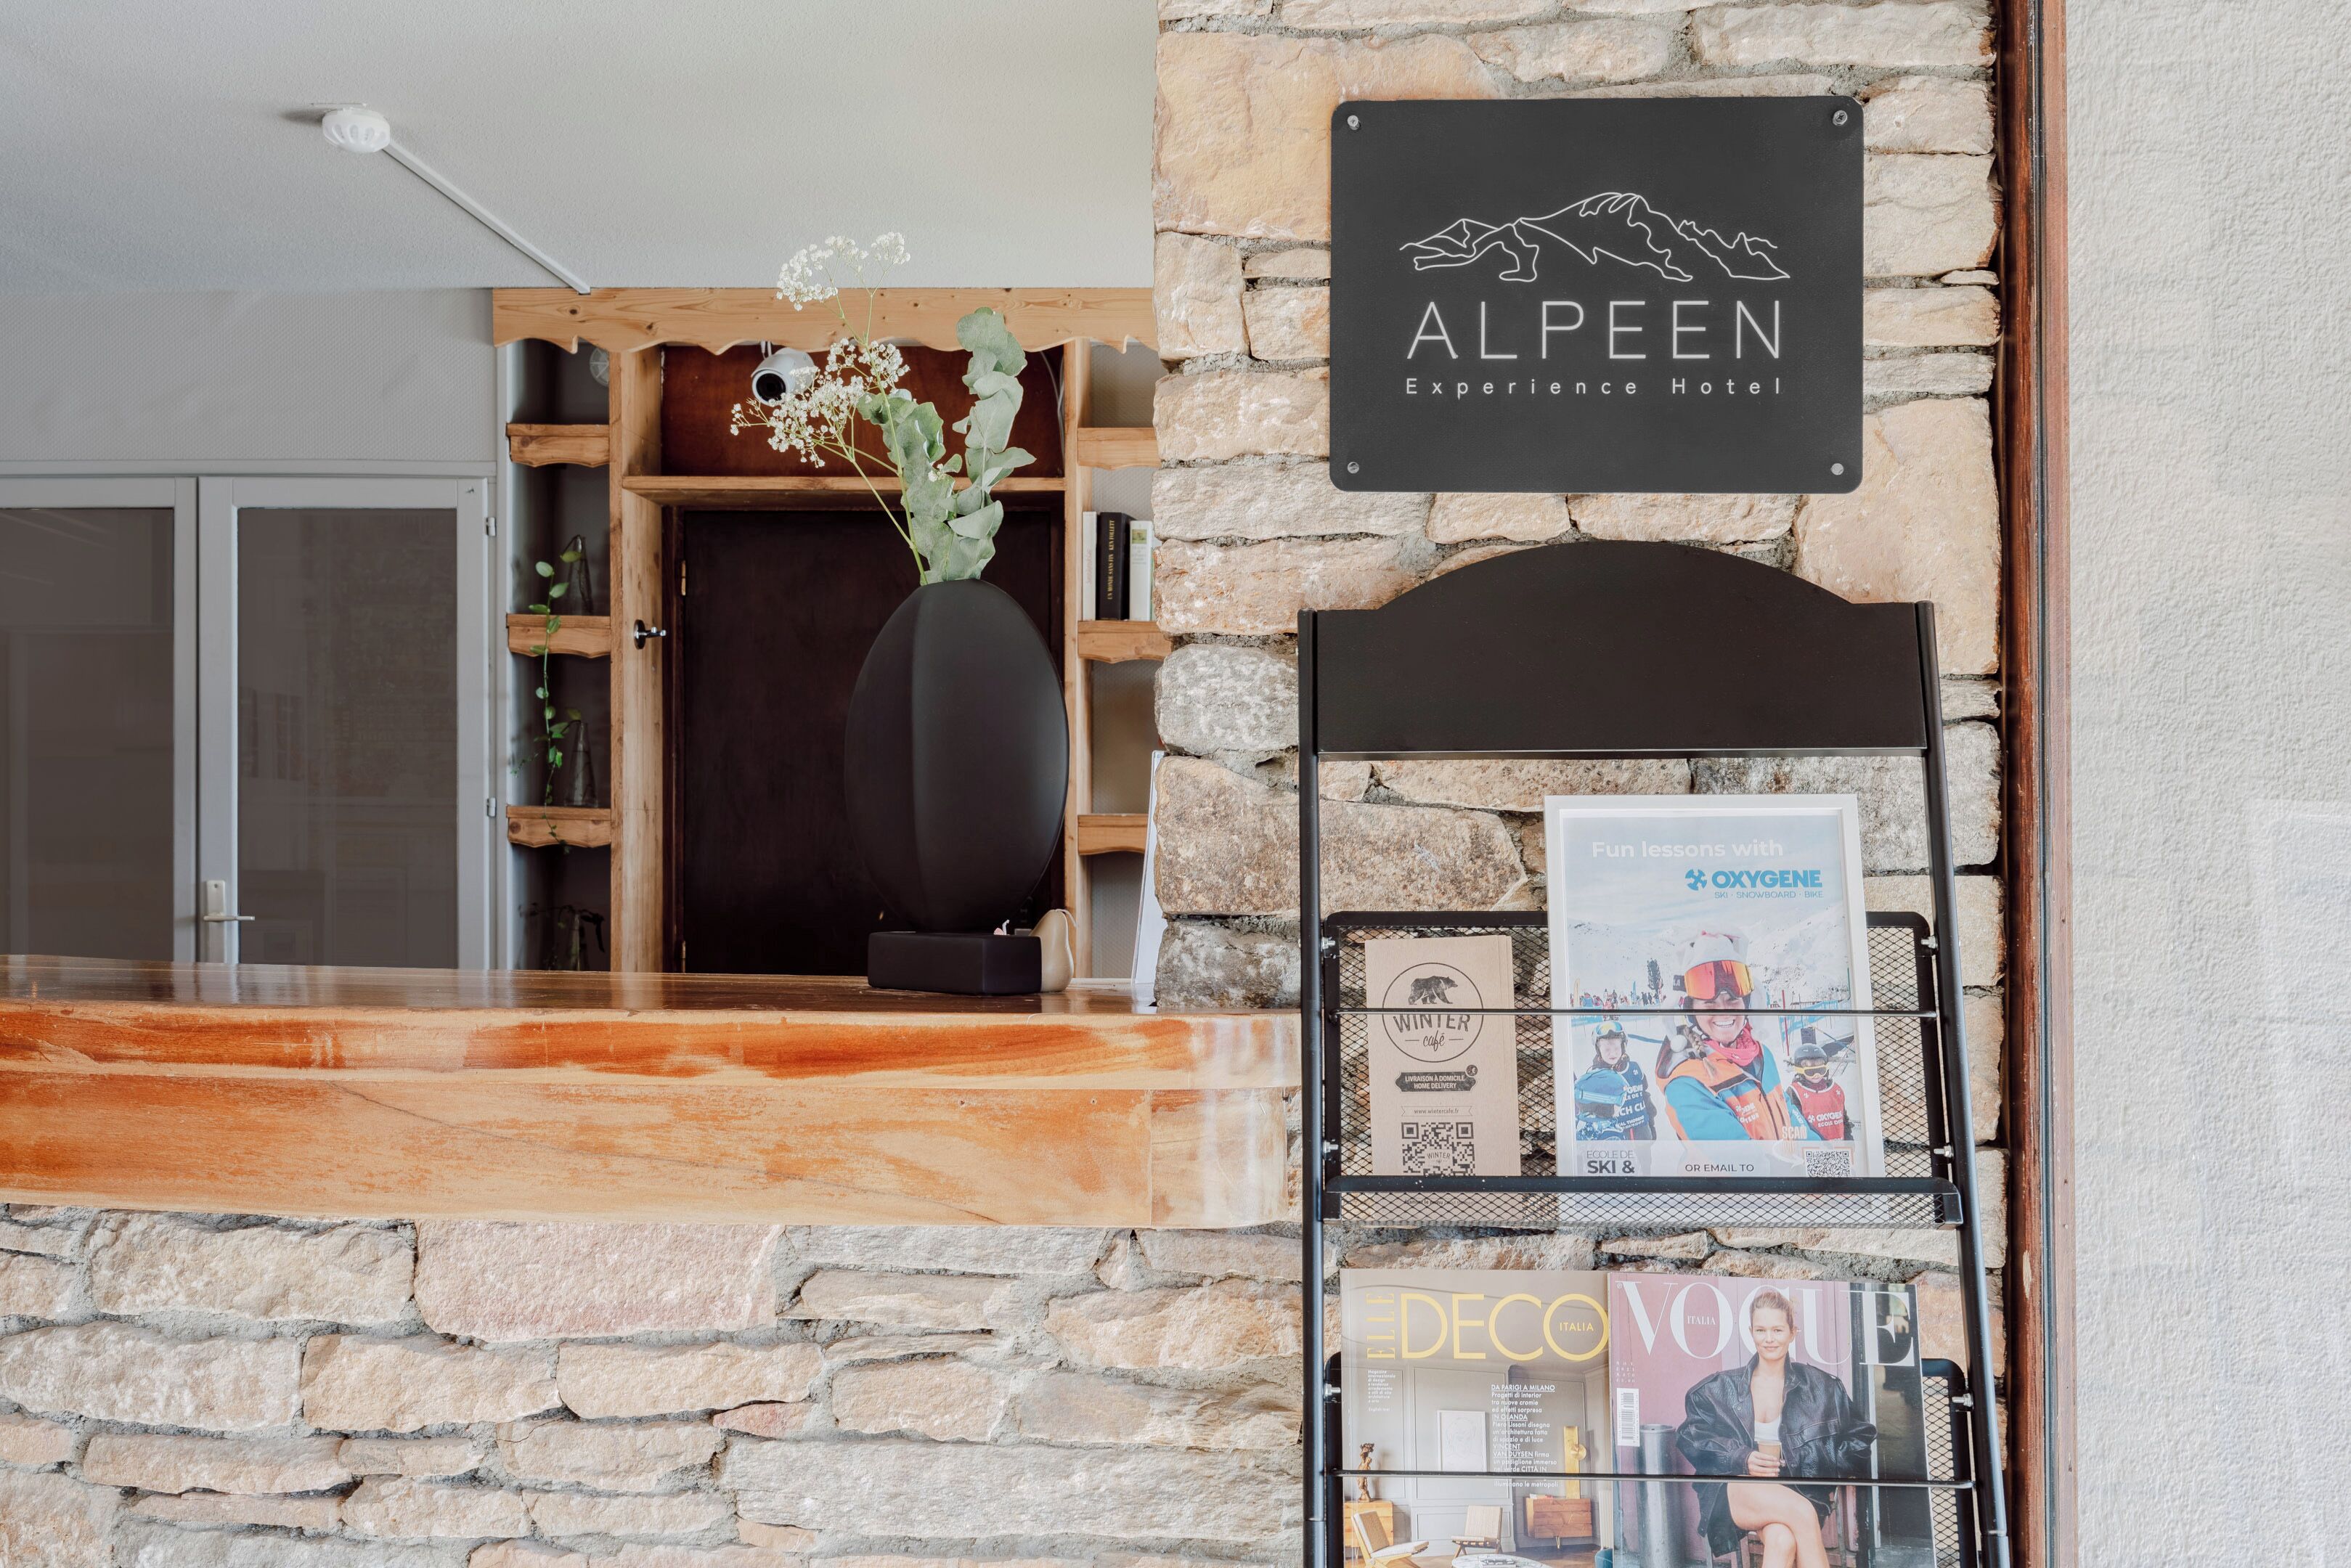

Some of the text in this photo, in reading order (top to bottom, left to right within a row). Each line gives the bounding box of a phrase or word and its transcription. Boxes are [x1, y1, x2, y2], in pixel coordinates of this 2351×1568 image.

[1406, 301, 1780, 359] ALPEEN
[1406, 377, 1779, 400] Experience Hotel
[1592, 839, 1784, 857] Fun lessons with
[1711, 870, 1823, 889] OXYGENE
[1714, 890, 1825, 899] SKI SNOWBOARD BIKE
[1393, 1014, 1471, 1033] WINTER
[1422, 1030, 1446, 1052] café
[1586, 1150, 1634, 1159] ECOLE DE
[1587, 1160, 1635, 1174] SKI &
[1366, 1293, 1395, 1360] ELLE
[1401, 1293, 1609, 1361] DECO
[1559, 1322, 1594, 1332] ITALIA
[1686, 1315, 1716, 1326] ITALIA
[1531, 1480, 1558, 1489] metropoli
